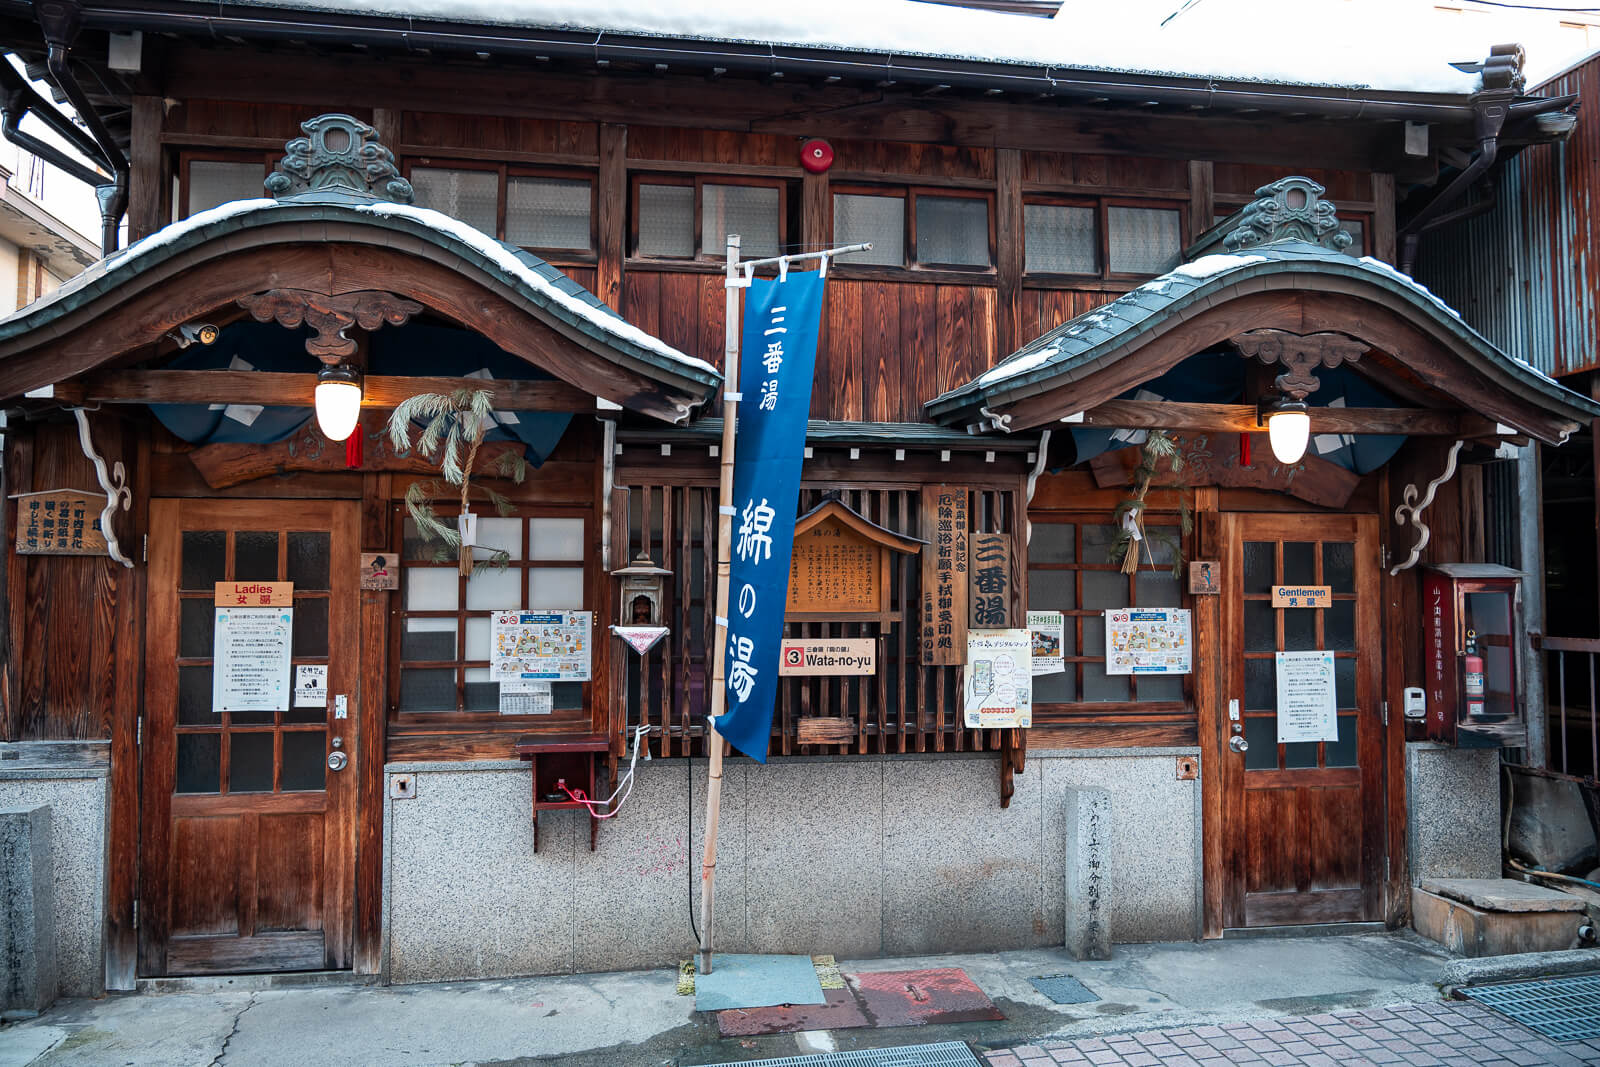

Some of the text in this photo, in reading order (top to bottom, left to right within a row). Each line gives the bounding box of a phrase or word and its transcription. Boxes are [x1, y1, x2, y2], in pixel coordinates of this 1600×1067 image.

[758, 306, 787, 411] 三番湯
[235, 584, 273, 594] Ladies
[937, 494, 953, 649] 厄除巡浴祈願手拭御受印処
[975, 536, 1007, 625] 三番湯
[1279, 588, 1326, 597] Gentlemen
[728, 498, 776, 703] 綿の湯
[789, 651, 799, 664] 3
[806, 655, 871, 668] Wata-no-yu
